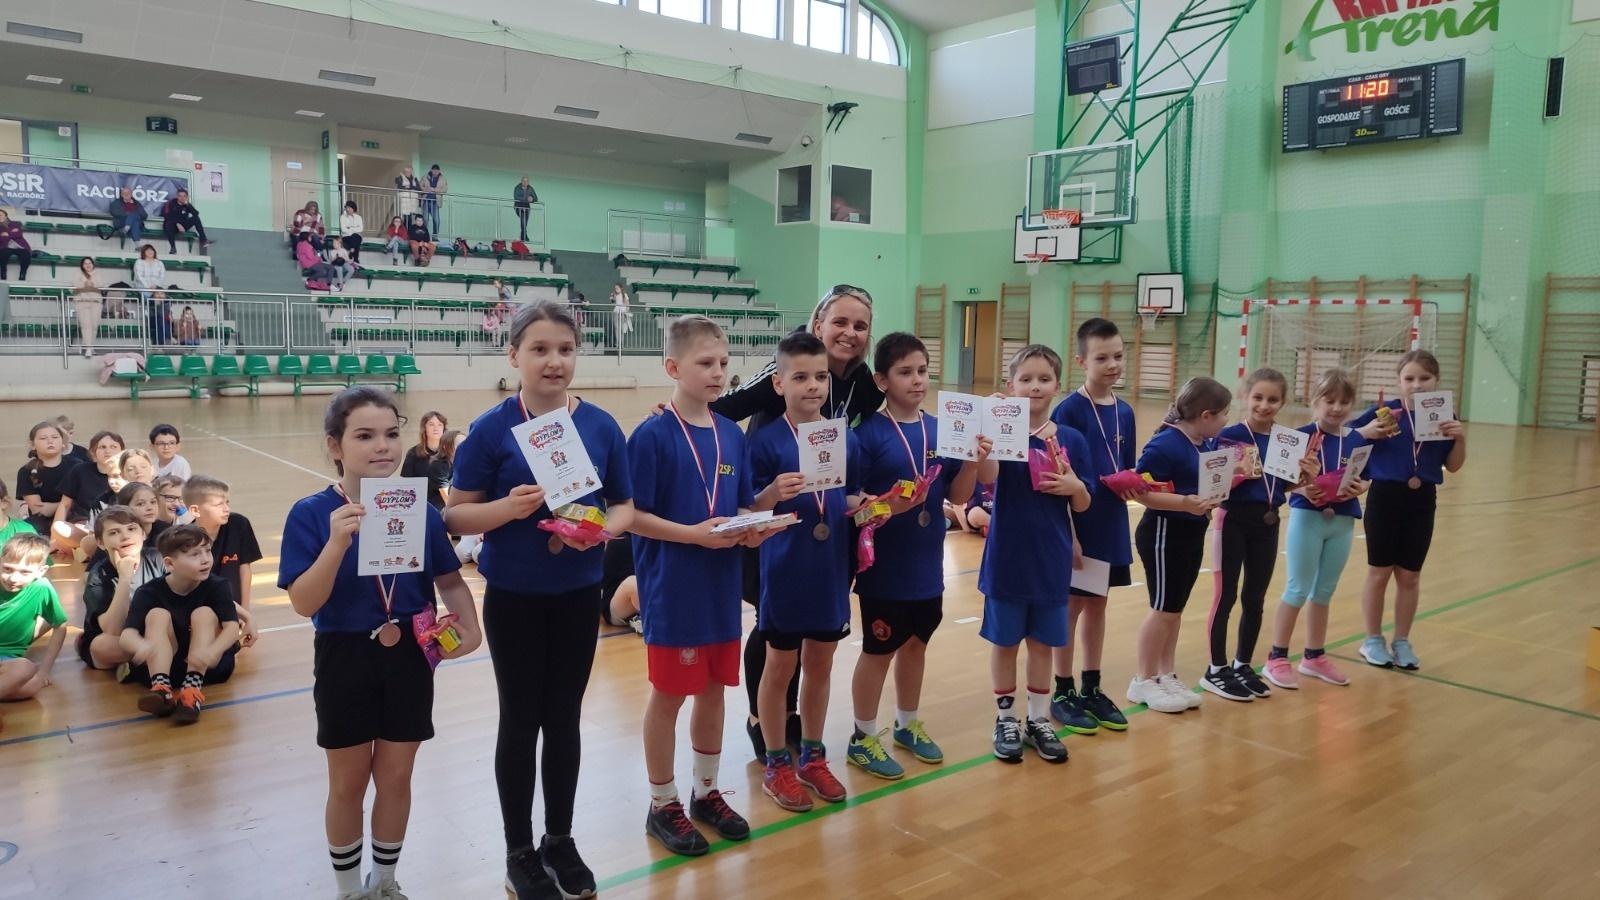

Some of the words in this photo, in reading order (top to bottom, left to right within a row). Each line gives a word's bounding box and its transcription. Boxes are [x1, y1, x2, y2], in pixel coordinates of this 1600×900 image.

[1285, 0, 1499, 61] Arena
[1347, 80, 1389, 100] 11:20
[1317, 111, 1360, 124] GOSPODARZE
[1384, 104, 1410, 116] GOŚCIE
[151, 121, 160, 130] F
[168, 123, 175, 131] F
[0, 172, 45, 193] SiR
[77, 184, 169, 203] RACIÓRZ
[536, 429, 560, 443] DYPLOM
